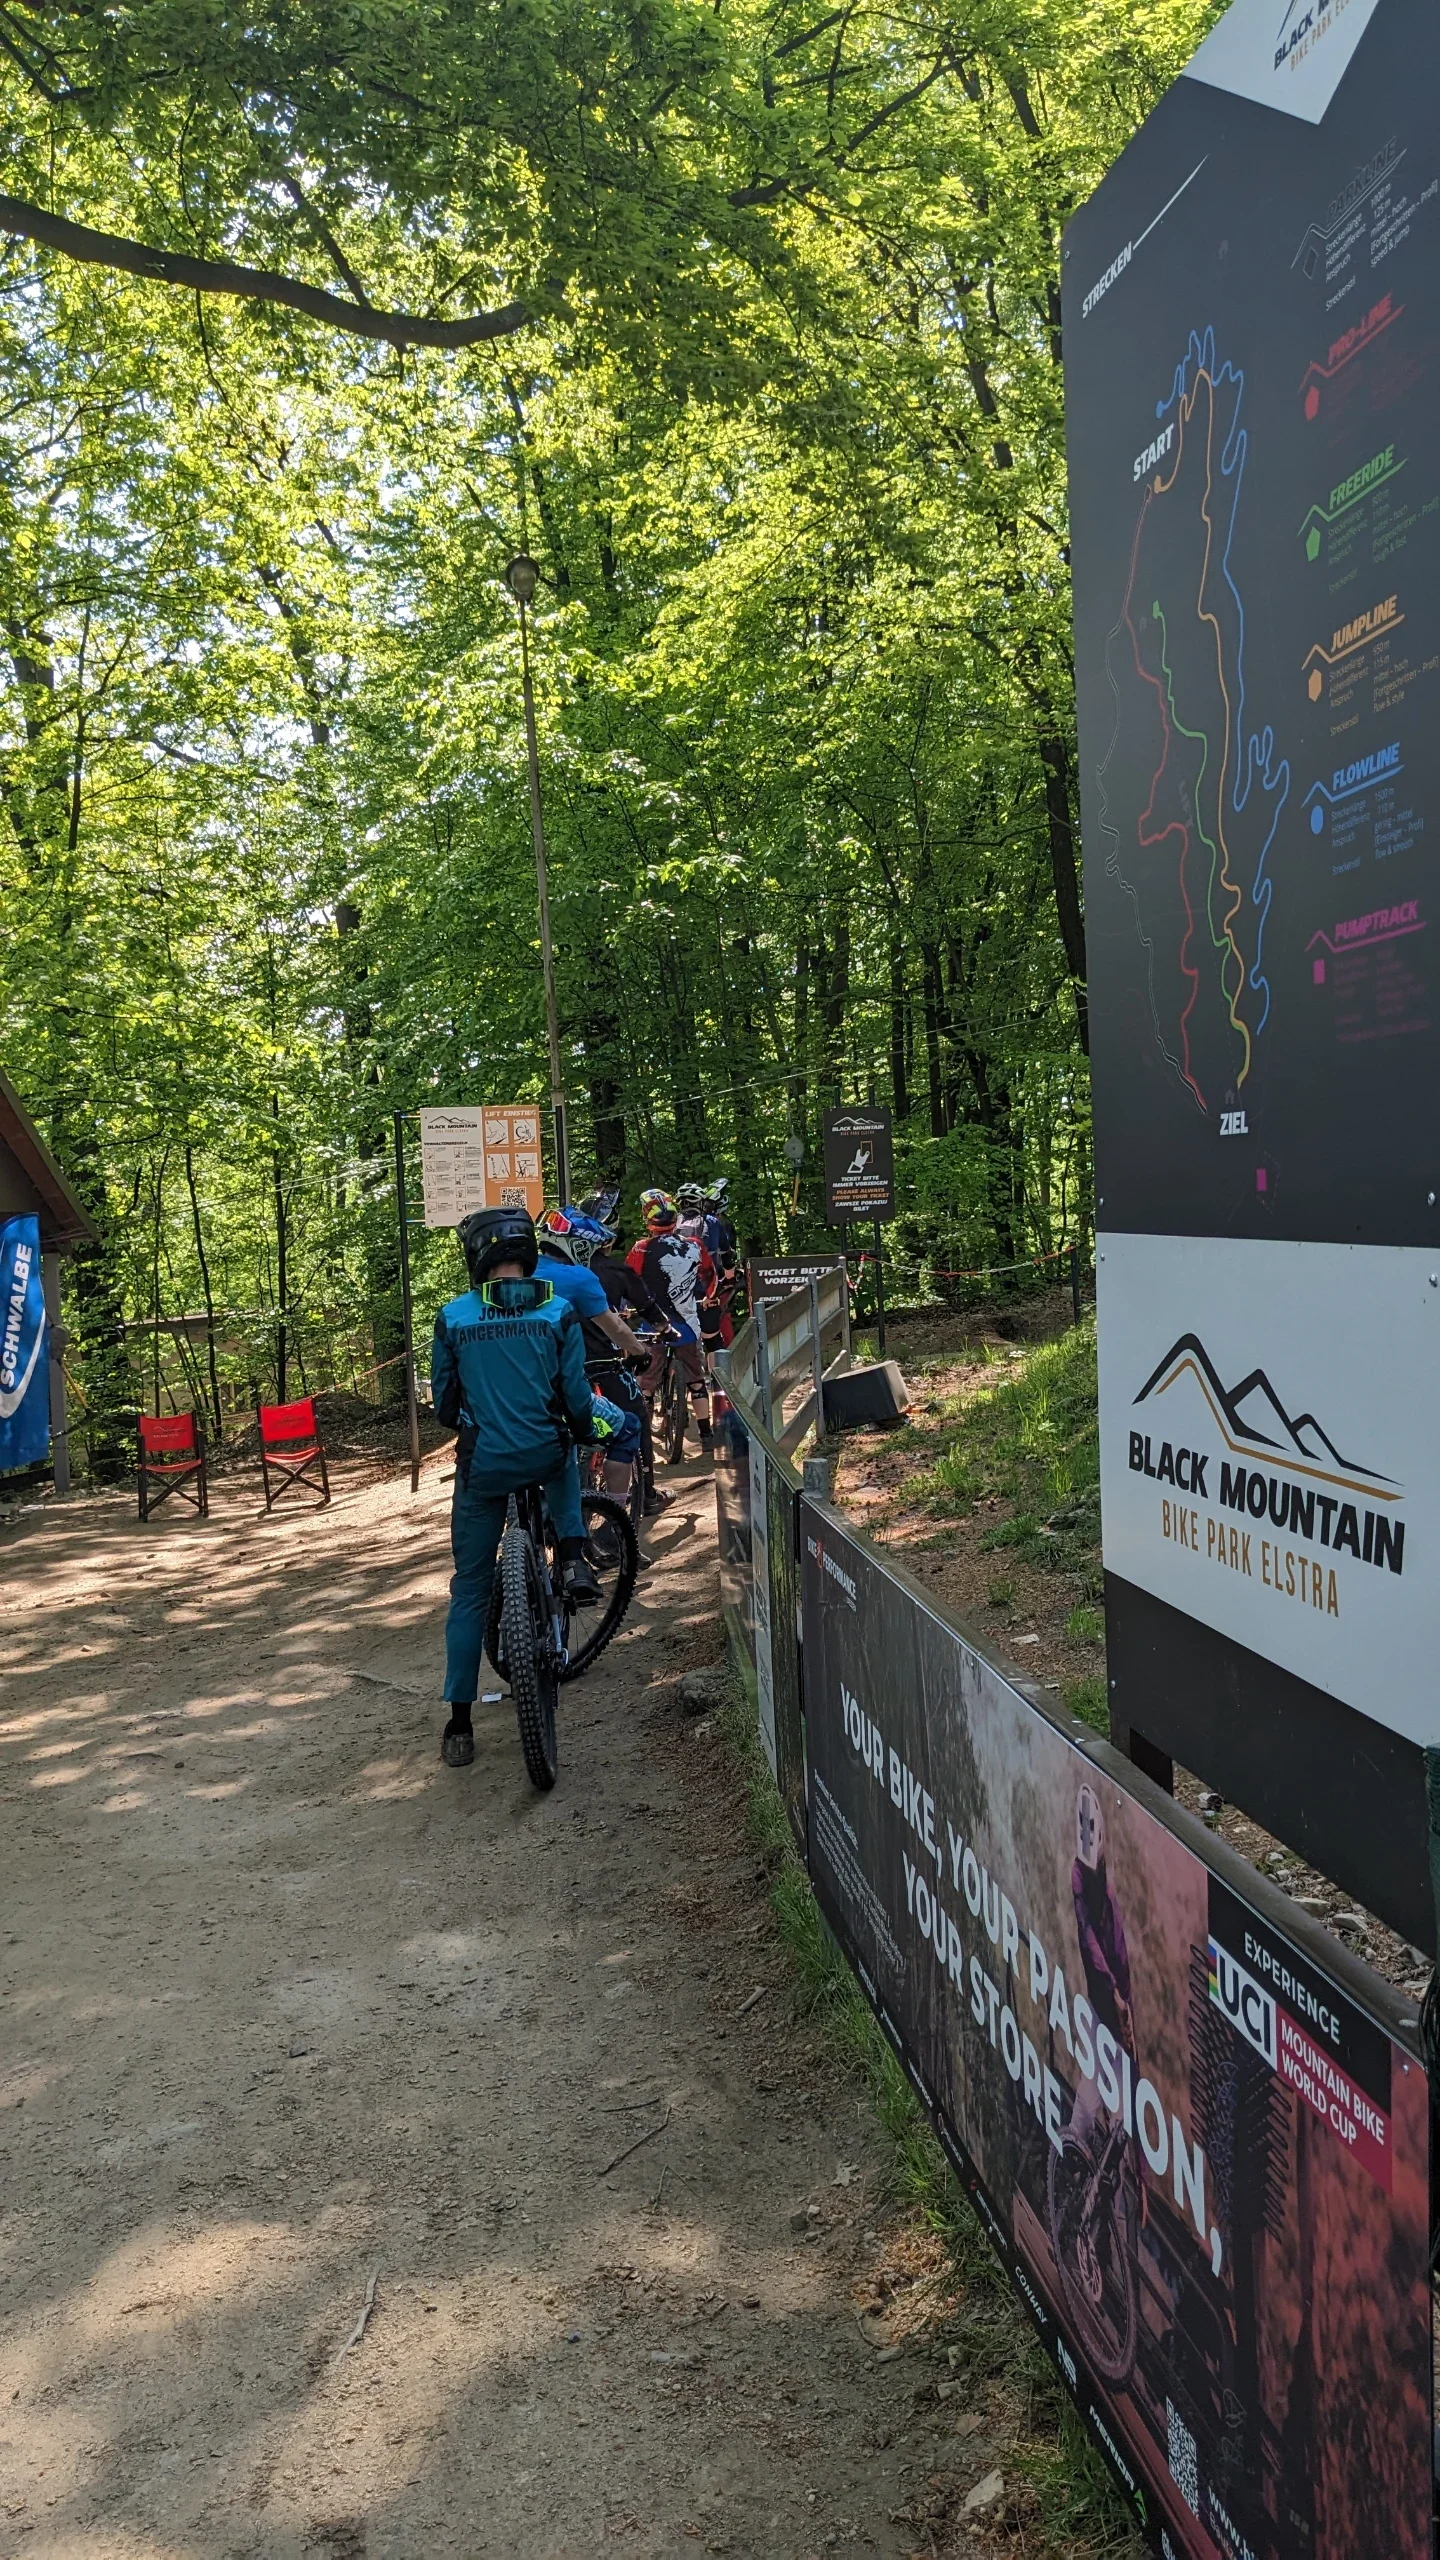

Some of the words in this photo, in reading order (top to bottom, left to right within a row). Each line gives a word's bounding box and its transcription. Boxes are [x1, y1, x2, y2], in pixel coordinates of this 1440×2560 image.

[1273, 6, 1313, 71] BLACK
[1290, 36, 1309, 72] BIKE
[1311, 9, 1332, 46] PARK
[1082, 241, 1133, 319] STRECKEN
[1133, 423, 1175, 482] START
[1329, 443, 1395, 511] FREERIDE
[1331, 594, 1398, 653] JUMPLINE
[1332, 741, 1400, 791] FLOWLINE
[1334, 899, 1419, 943] PUMPTRACK
[1219, 1110, 1249, 1135] ZIEL
[757, 1268, 797, 1277] TICKET
[1, 1242, 33, 1388] SCHWALBE
[460, 1321, 548, 1346] ANGERMANN
[478, 1304, 525, 1321] JONAS
[1128, 1430, 1210, 1499] BLACK
[1219, 1461, 1405, 1576] MOUNTAIN
[822, 1550, 857, 1601] PERFORMANCE
[1162, 1499, 1199, 1552] BIKE
[1207, 1517, 1252, 1577] PARK
[1261, 1540, 1339, 1618] ELSTRA
[839, 1681, 885, 1788] YOUR
[889, 1746, 945, 1877] BIKE,
[947, 1820, 1020, 1978] YOUR
[1028, 1928, 1223, 2278] PASSION,
[901, 1849, 964, 1995] YOUR
[968, 1955, 1064, 2158] STORE
[1218, 1953, 1271, 2057] UCI
[1244, 1932, 1341, 2045] EXPERIENCE
[1281, 2018, 1350, 2110] MOUNTAIN
[1353, 2092, 1385, 2145] BIKE
[1281, 2048, 1327, 2115] WORLD
[1329, 2103, 1358, 2145] CUP
[1014, 2265, 1048, 2325] CONWAY
[1089, 2404, 1135, 2491] MERIDA
